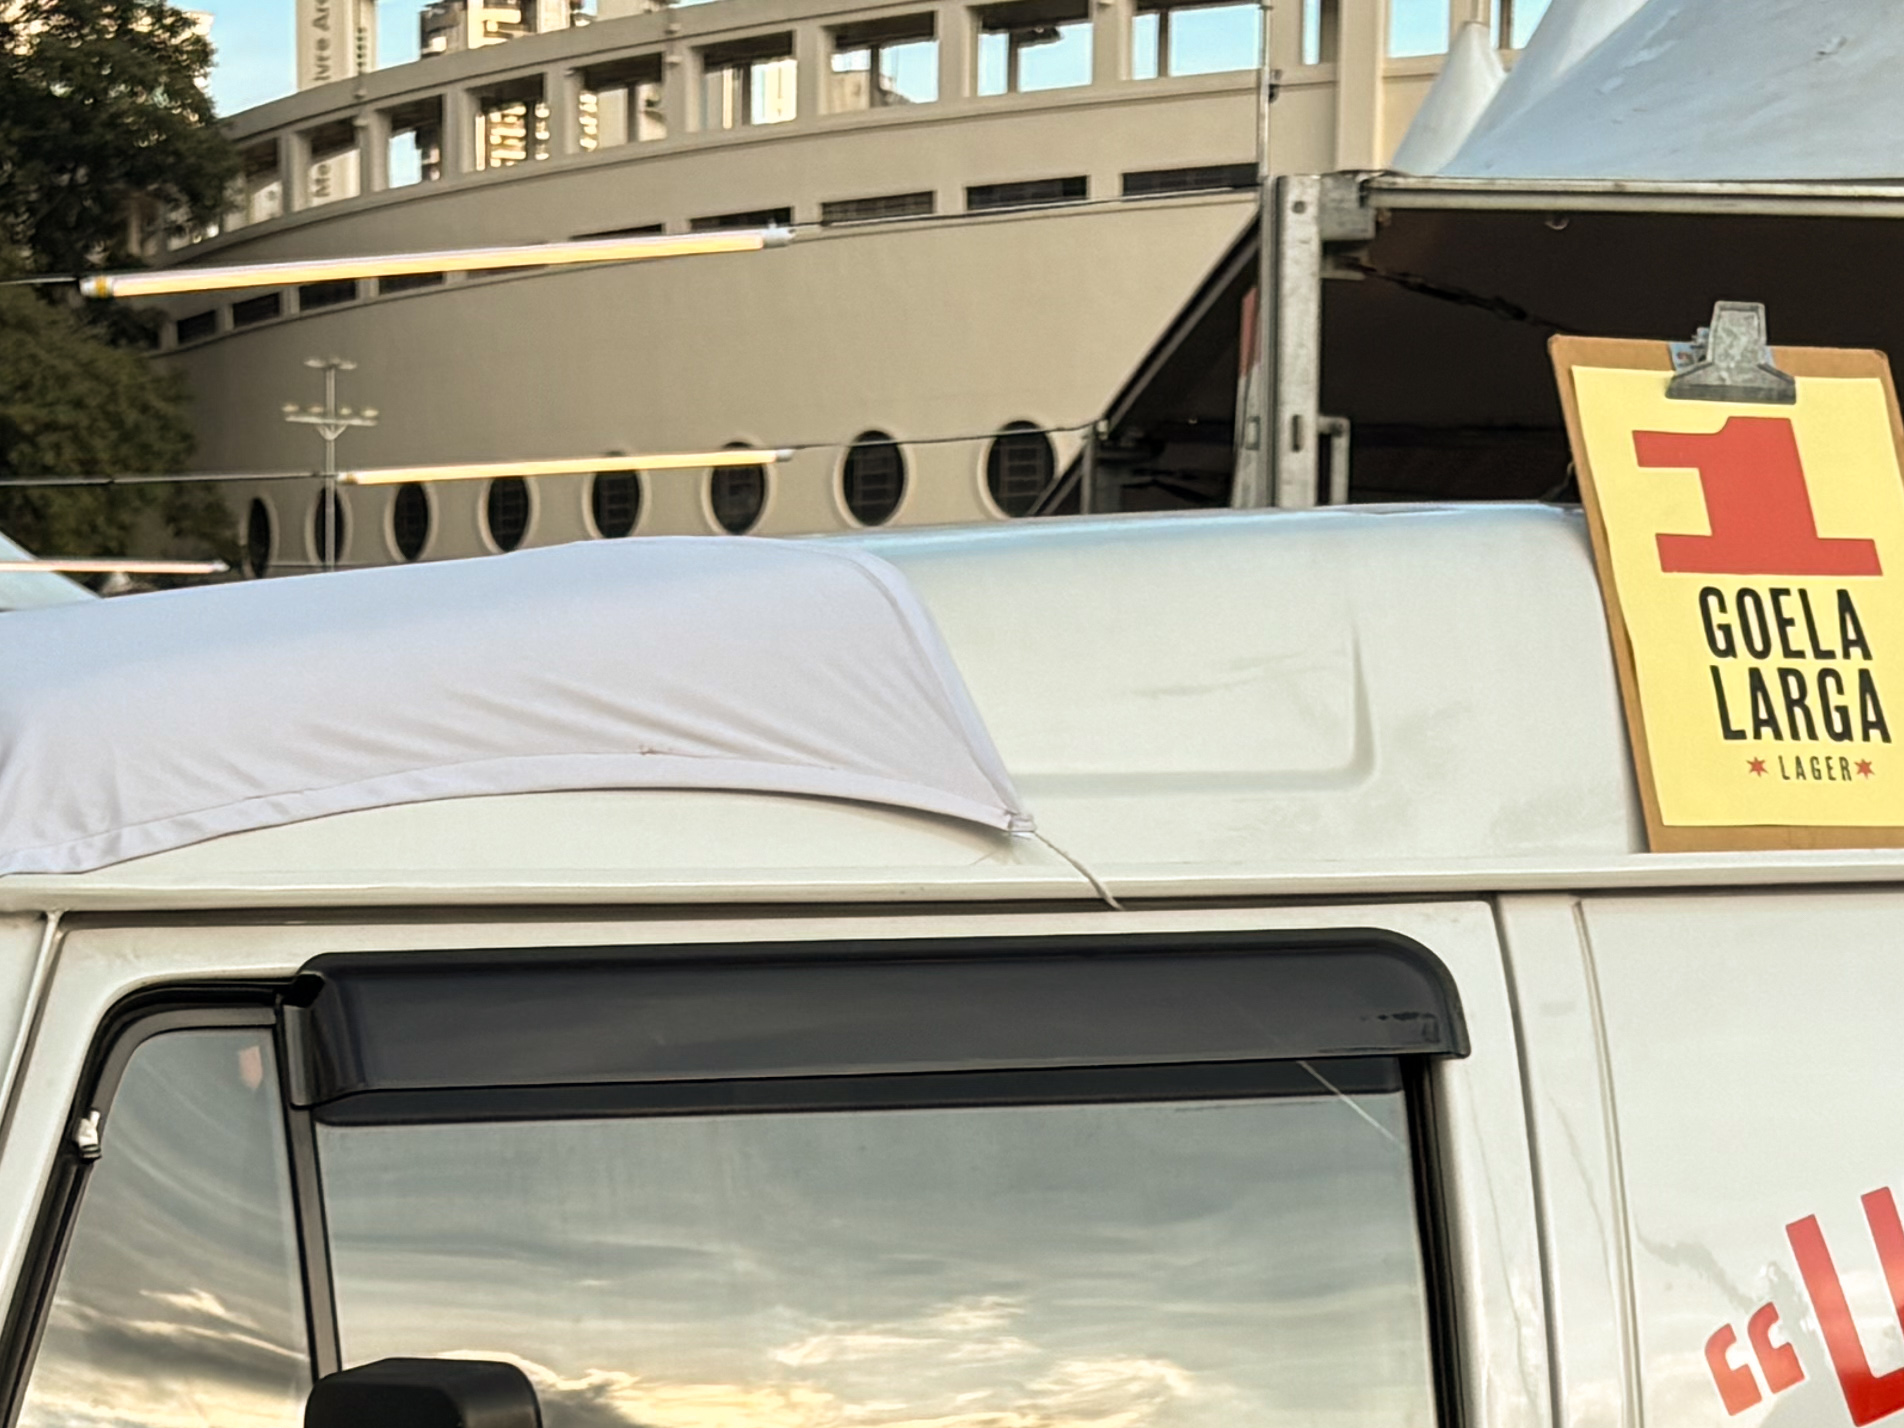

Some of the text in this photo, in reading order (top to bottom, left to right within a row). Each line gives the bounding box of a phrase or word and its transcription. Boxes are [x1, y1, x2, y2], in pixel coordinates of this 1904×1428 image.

[1631, 416, 1883, 577] 1
[1699, 587, 1874, 661] GOELA
[1708, 666, 1892, 745] LARGA
[1779, 754, 1853, 783] LAGER
